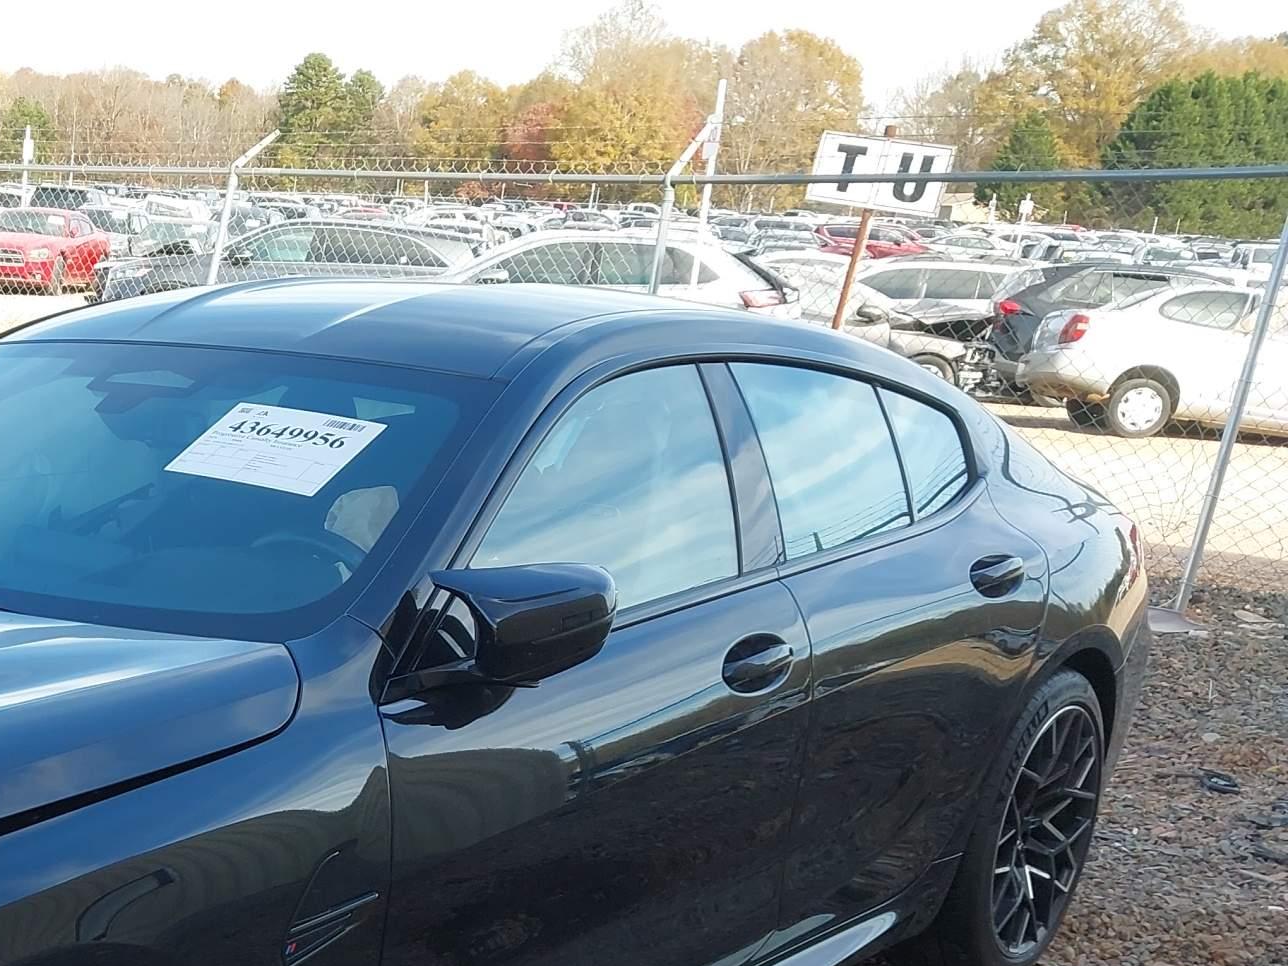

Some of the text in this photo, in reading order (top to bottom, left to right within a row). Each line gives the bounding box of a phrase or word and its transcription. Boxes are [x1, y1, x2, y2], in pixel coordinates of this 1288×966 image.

[837, 143, 936, 203] T U
[228, 419, 352, 449] 43649956
